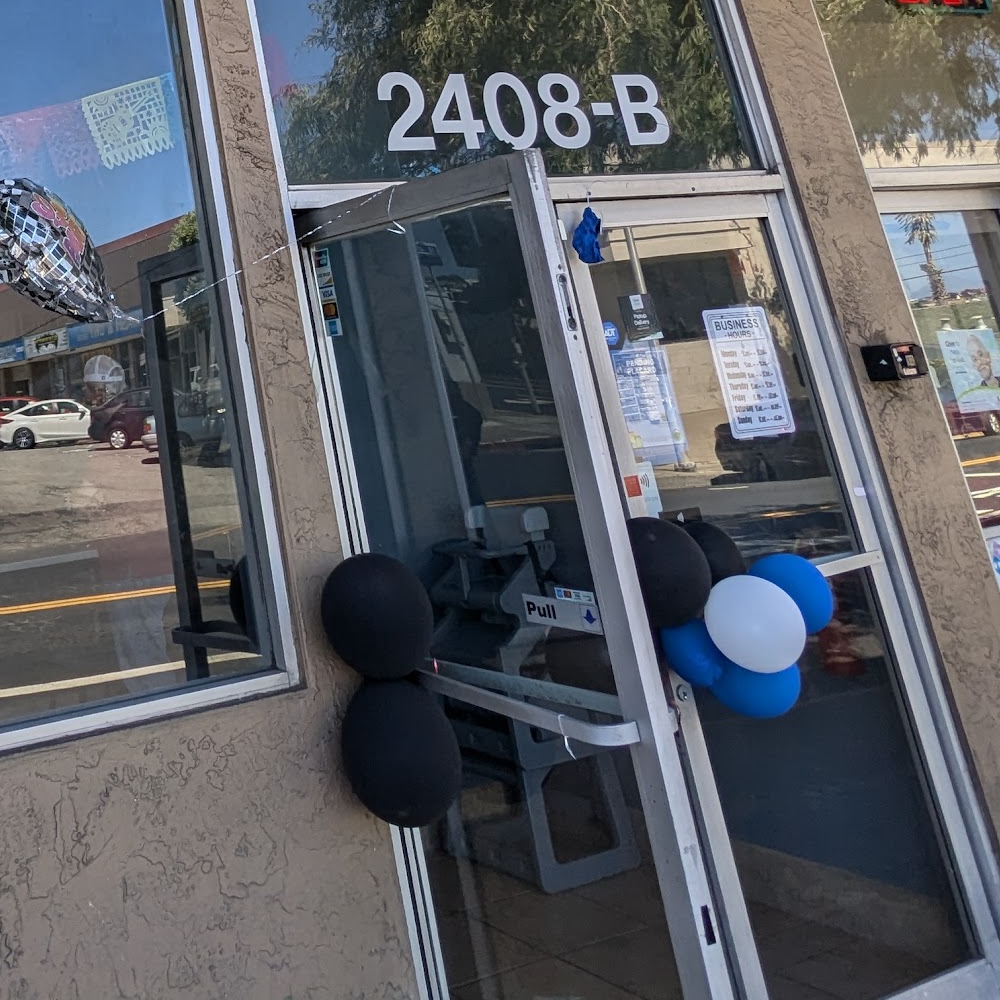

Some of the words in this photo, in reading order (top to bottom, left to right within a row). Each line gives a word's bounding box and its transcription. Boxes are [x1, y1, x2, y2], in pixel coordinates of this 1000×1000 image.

[377, 71, 670, 151] 2408-B
[714, 318, 759, 331] BUSINESS
[525, 600, 557, 620] Pull
